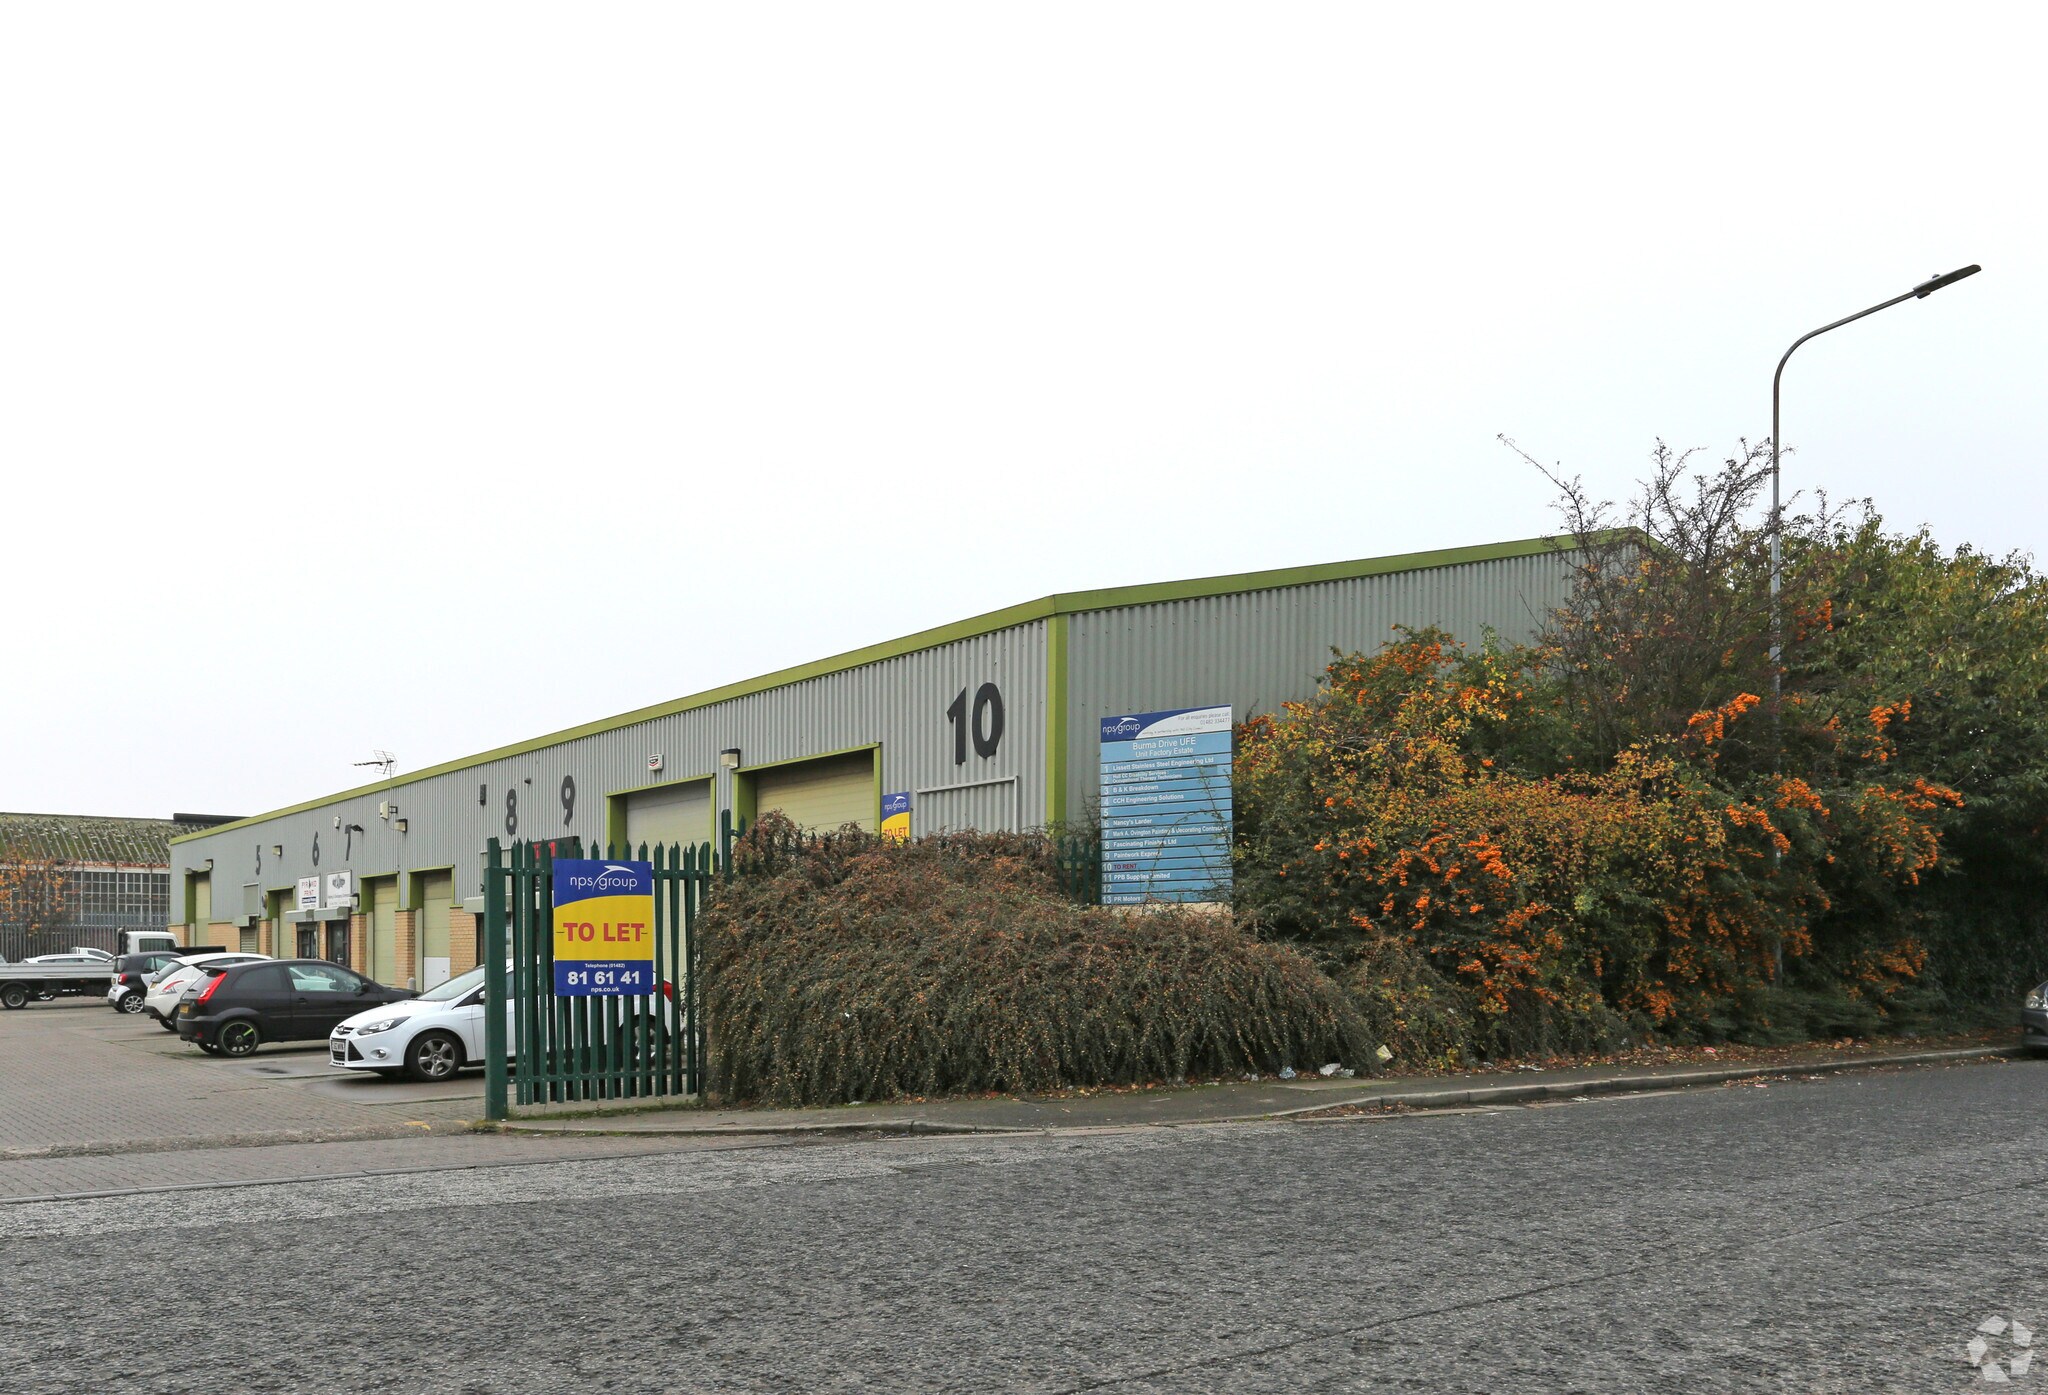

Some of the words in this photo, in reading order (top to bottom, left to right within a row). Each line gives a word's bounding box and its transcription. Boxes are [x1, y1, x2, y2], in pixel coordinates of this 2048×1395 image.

[946, 682, 1004, 765] 10
[1132, 742, 1156, 750] Burma
[1158, 740, 1177, 748] Drive
[1180, 736, 1196, 746] UFE
[1135, 750, 1148, 758] Unit
[1149, 748, 1172, 757] Factory
[1131, 762, 1155, 770] Stainless
[1171, 759, 1203, 767] Engineering
[1103, 776, 1109, 784] 2
[1103, 786, 1109, 795] 3
[1129, 784, 1159, 792] Breakdown
[561, 775, 576, 827] 9
[1103, 797, 1109, 806] 4
[1126, 795, 1158, 803] Engineering
[505, 788, 517, 836] 8
[1103, 808, 1109, 817] 5
[1104, 820, 1109, 828] 6
[895, 827, 907, 837] LET
[1104, 831, 1109, 839] 7
[344, 824, 351, 862] 7
[1113, 840, 1143, 848] Fascinating
[312, 831, 320, 867] 6
[255, 844, 261, 876] 5
[1102, 863, 1112, 871] 10
[1102, 874, 1112, 882] 11
[1102, 885, 1112, 893] 12
[1102, 896, 1112, 904] 13
[563, 922, 595, 942] TO
[603, 922, 645, 942] LET
[567, 971, 587, 985] 81
[594, 971, 614, 985] 61
[620, 971, 640, 985] 41
